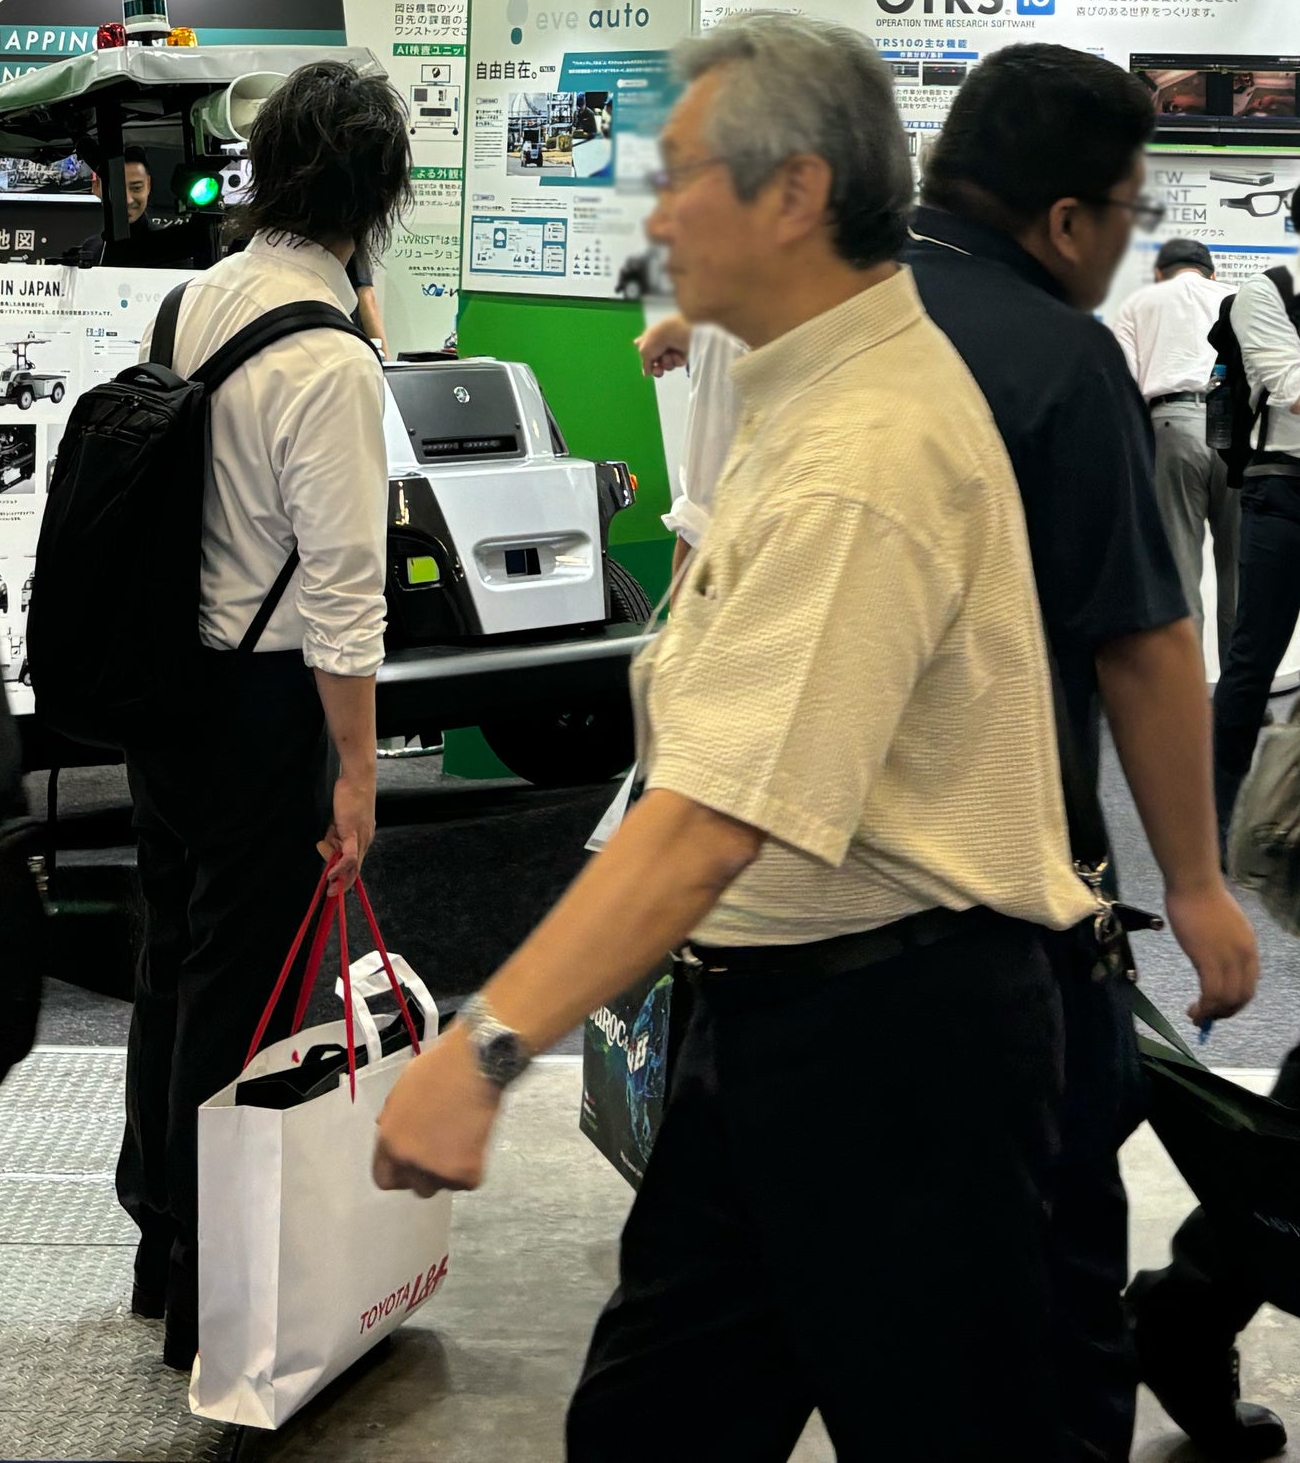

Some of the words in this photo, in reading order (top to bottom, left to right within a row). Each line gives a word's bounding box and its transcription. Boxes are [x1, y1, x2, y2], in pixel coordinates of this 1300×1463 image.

[588, 2, 650, 29] auto
[876, 18, 921, 28] OPERATION
[924, 19, 944, 28] TIME
[946, 19, 988, 28] RESEARCH
[991, 19, 1036, 28] SOFTWARE
[870, 38, 967, 49] TRS10の主な機能
[476, 59, 538, 80] 自由自在。
[1, 280, 13, 296] IN
[360, 1282, 410, 1335] TOYOTA
